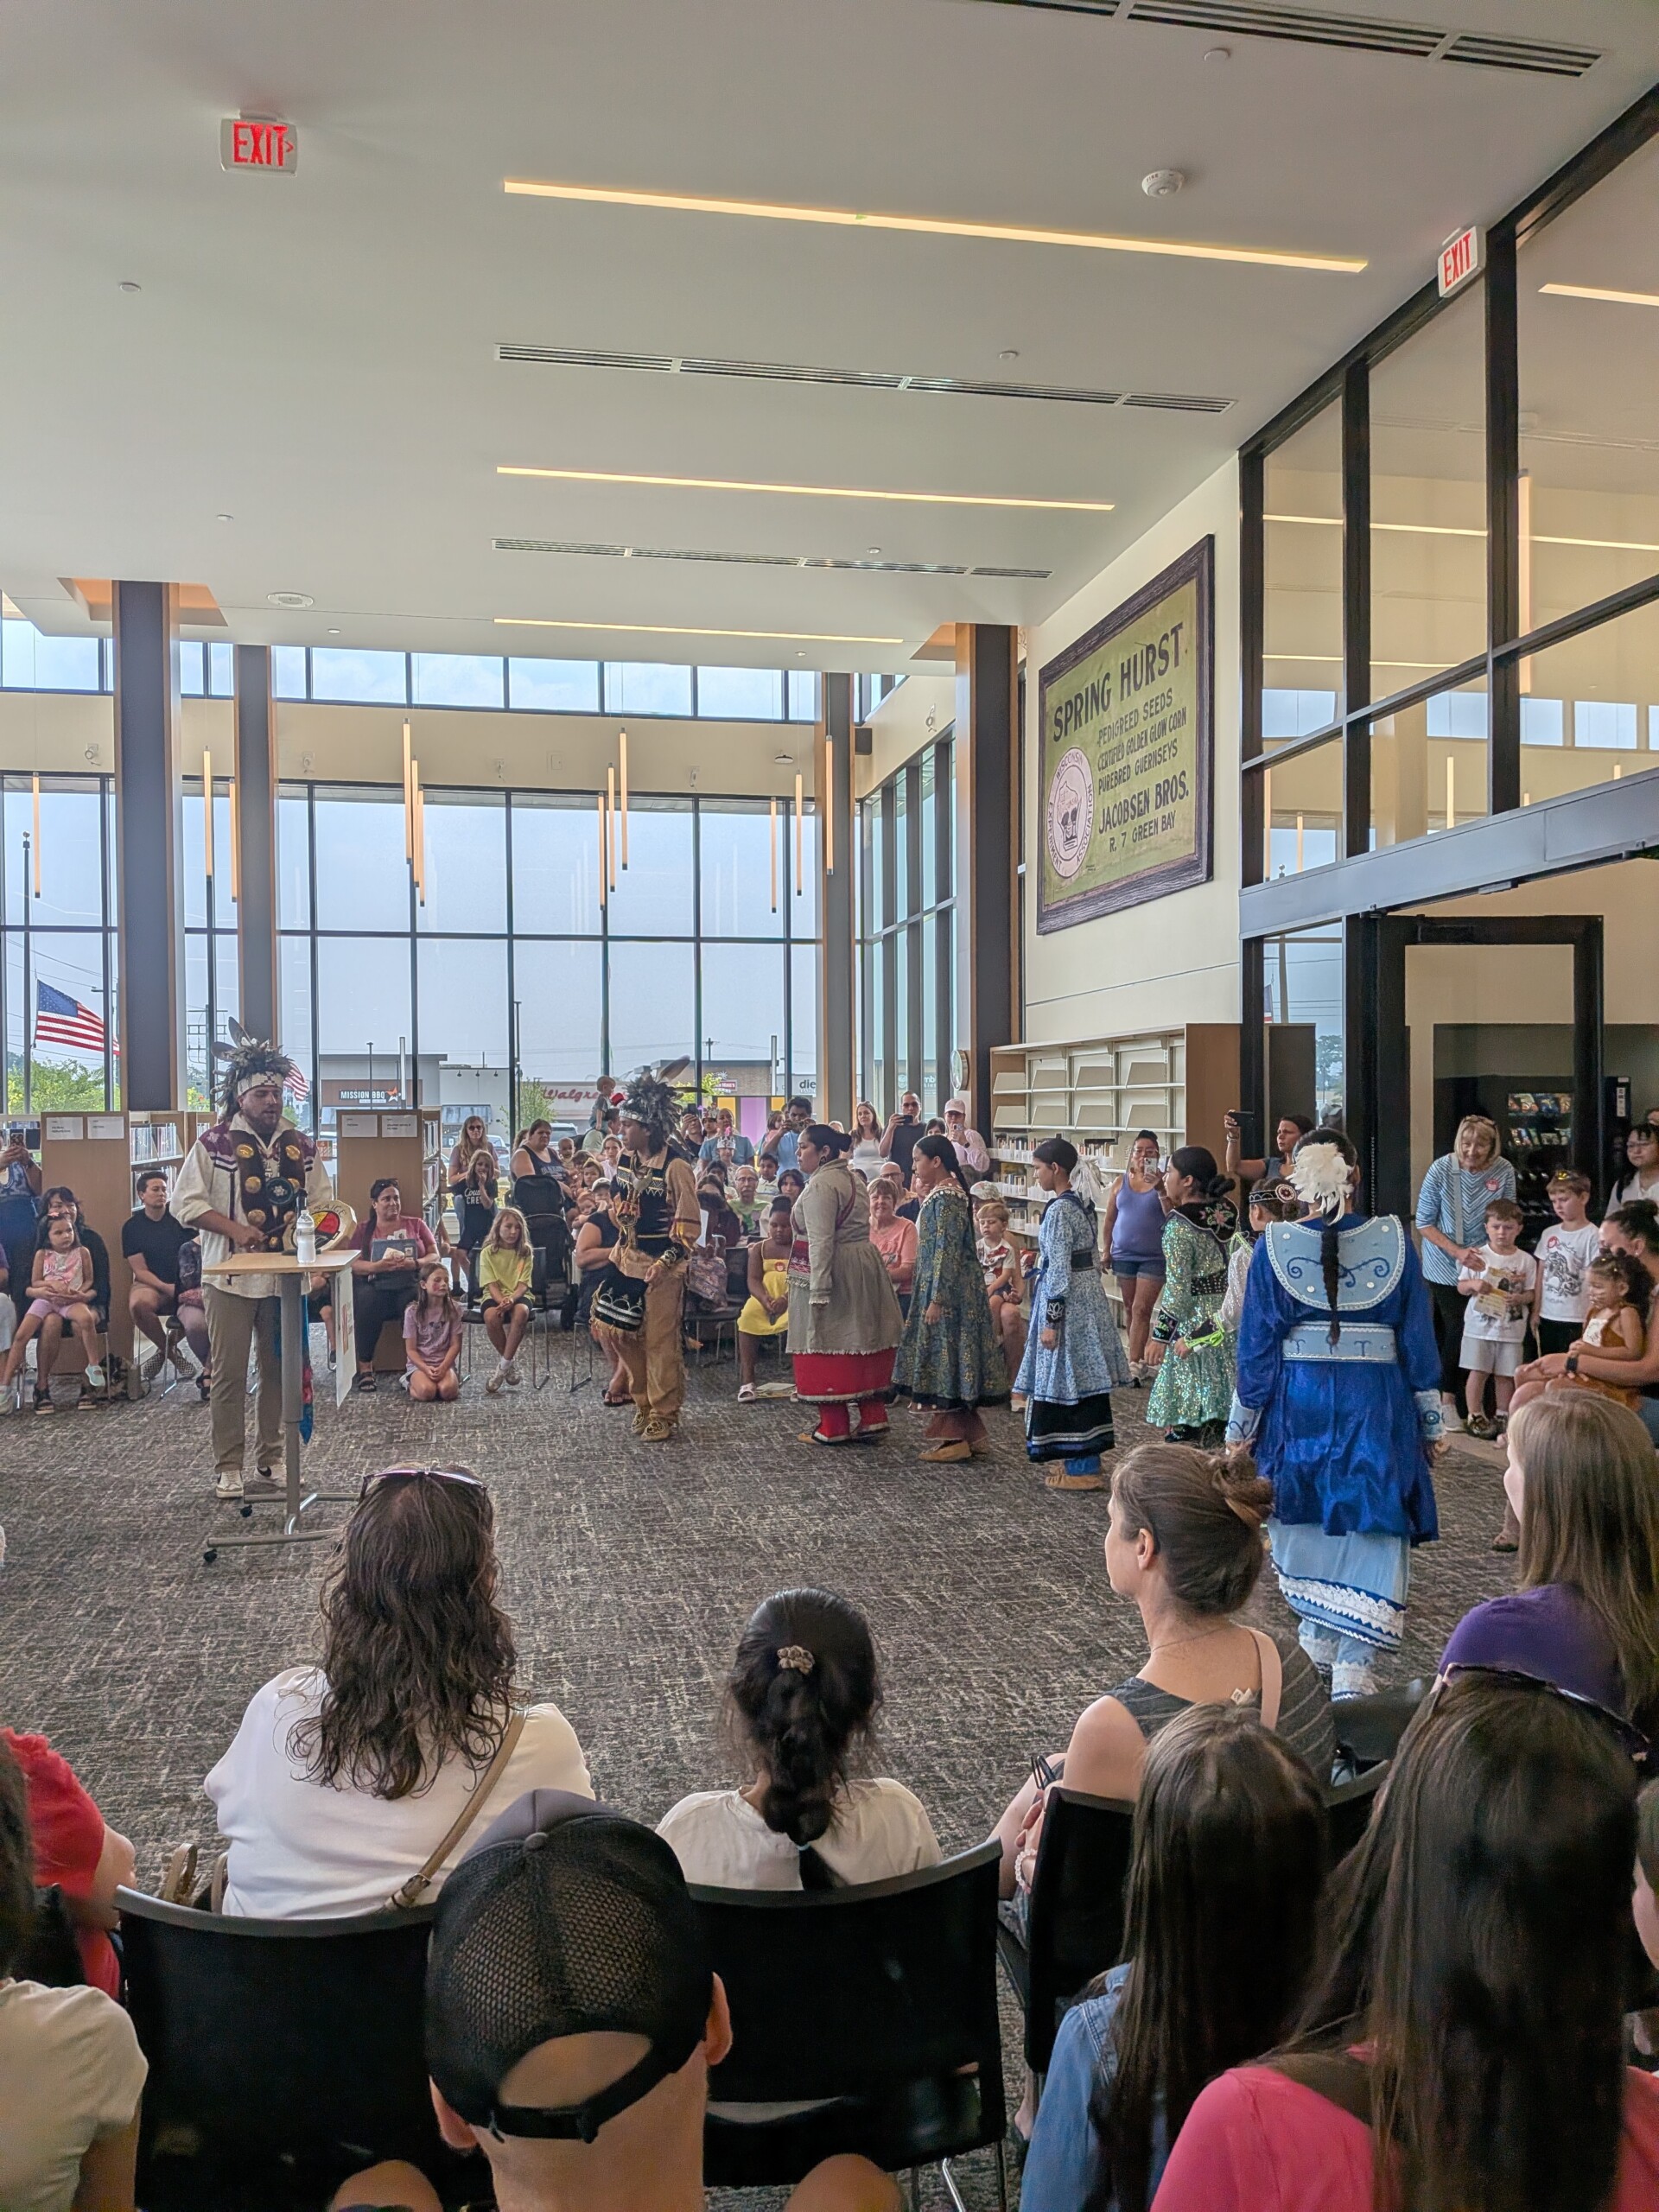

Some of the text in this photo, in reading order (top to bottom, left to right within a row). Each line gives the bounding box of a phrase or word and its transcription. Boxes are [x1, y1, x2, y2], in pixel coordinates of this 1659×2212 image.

[233, 121, 288, 166] EXIT
[1443, 232, 1471, 289] EXIT
[1053, 672, 1112, 742] SPRING
[1098, 687, 1173, 747] PEDIGREED SEEDS
[1056, 752, 1084, 780] WISCONSIN
[1097, 706, 1186, 772] CERTIFIED GOLDEN GLOW CORN
[1098, 738, 1178, 795] PUREBRED GUERNSEYS
[1076, 783, 1093, 866] ASSOCIATION
[1098, 787, 1150, 835] JACOBSEN
[1154, 770, 1189, 810] BROS.
[1109, 810, 1176, 853] R. 7 GREEN BAY
[340, 1090, 385, 1100] MISSION BBQ
[467, 1196, 482, 1205] CRE
